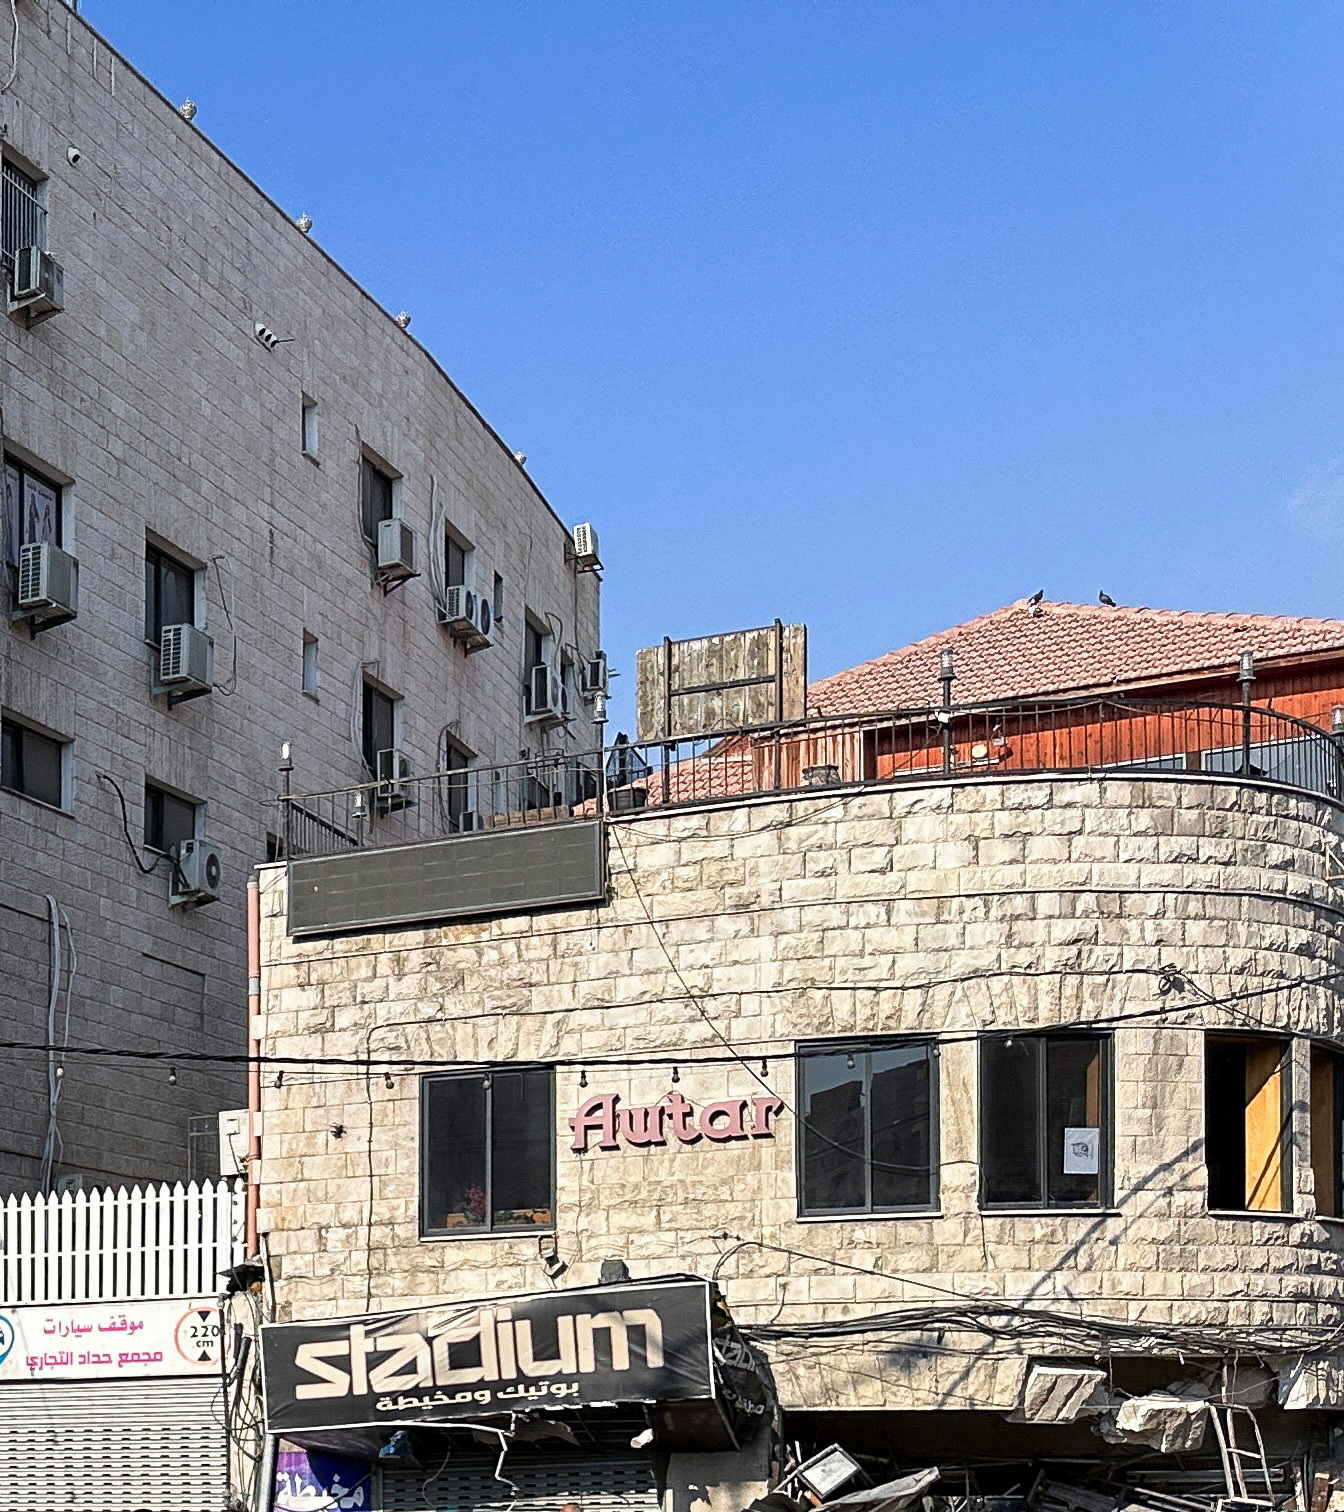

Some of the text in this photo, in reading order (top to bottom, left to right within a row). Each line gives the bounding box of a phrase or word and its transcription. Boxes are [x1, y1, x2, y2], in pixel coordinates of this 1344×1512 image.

[568, 1093, 782, 1149] Autar
[43, 1316, 144, 1338] موقف سيارات
[190, 1325, 219, 1338] 220
[196, 1339, 214, 1348] cm
[293, 1306, 666, 1401] stadium
[25, 1350, 163, 1373] مجمع حداد التجاري
[374, 1379, 580, 1413] بوتيك ومخيطة
